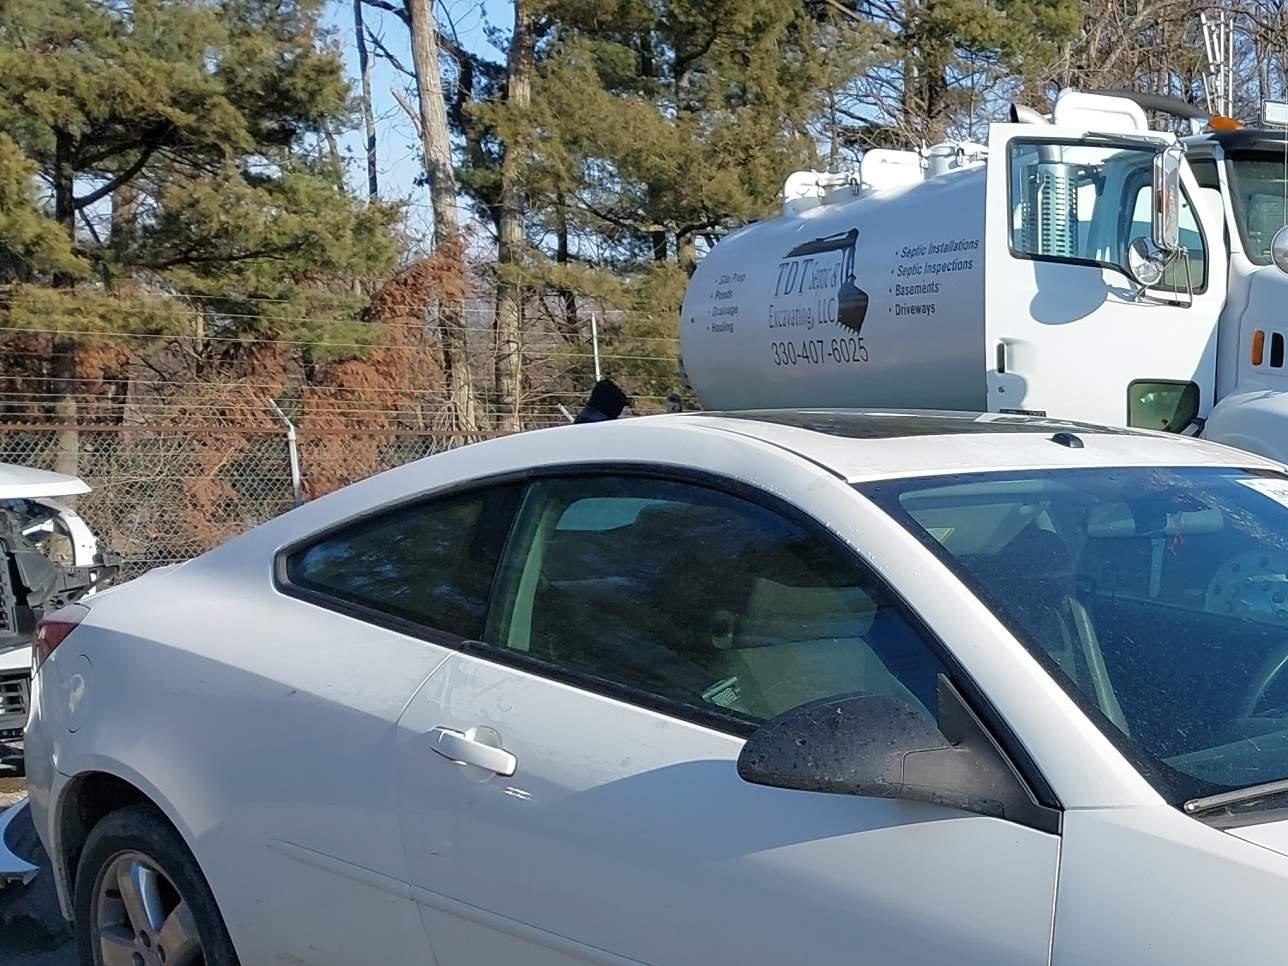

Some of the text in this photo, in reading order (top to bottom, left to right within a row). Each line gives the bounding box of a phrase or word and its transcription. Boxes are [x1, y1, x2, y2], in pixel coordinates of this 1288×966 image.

[900, 239, 980, 259] Septic Installations
[774, 258, 815, 297] TDT
[897, 259, 974, 279] Septic Inspections
[895, 281, 940, 297] Basements
[895, 303, 936, 317] Driveways
[771, 337, 869, 366] 330-407-6025
